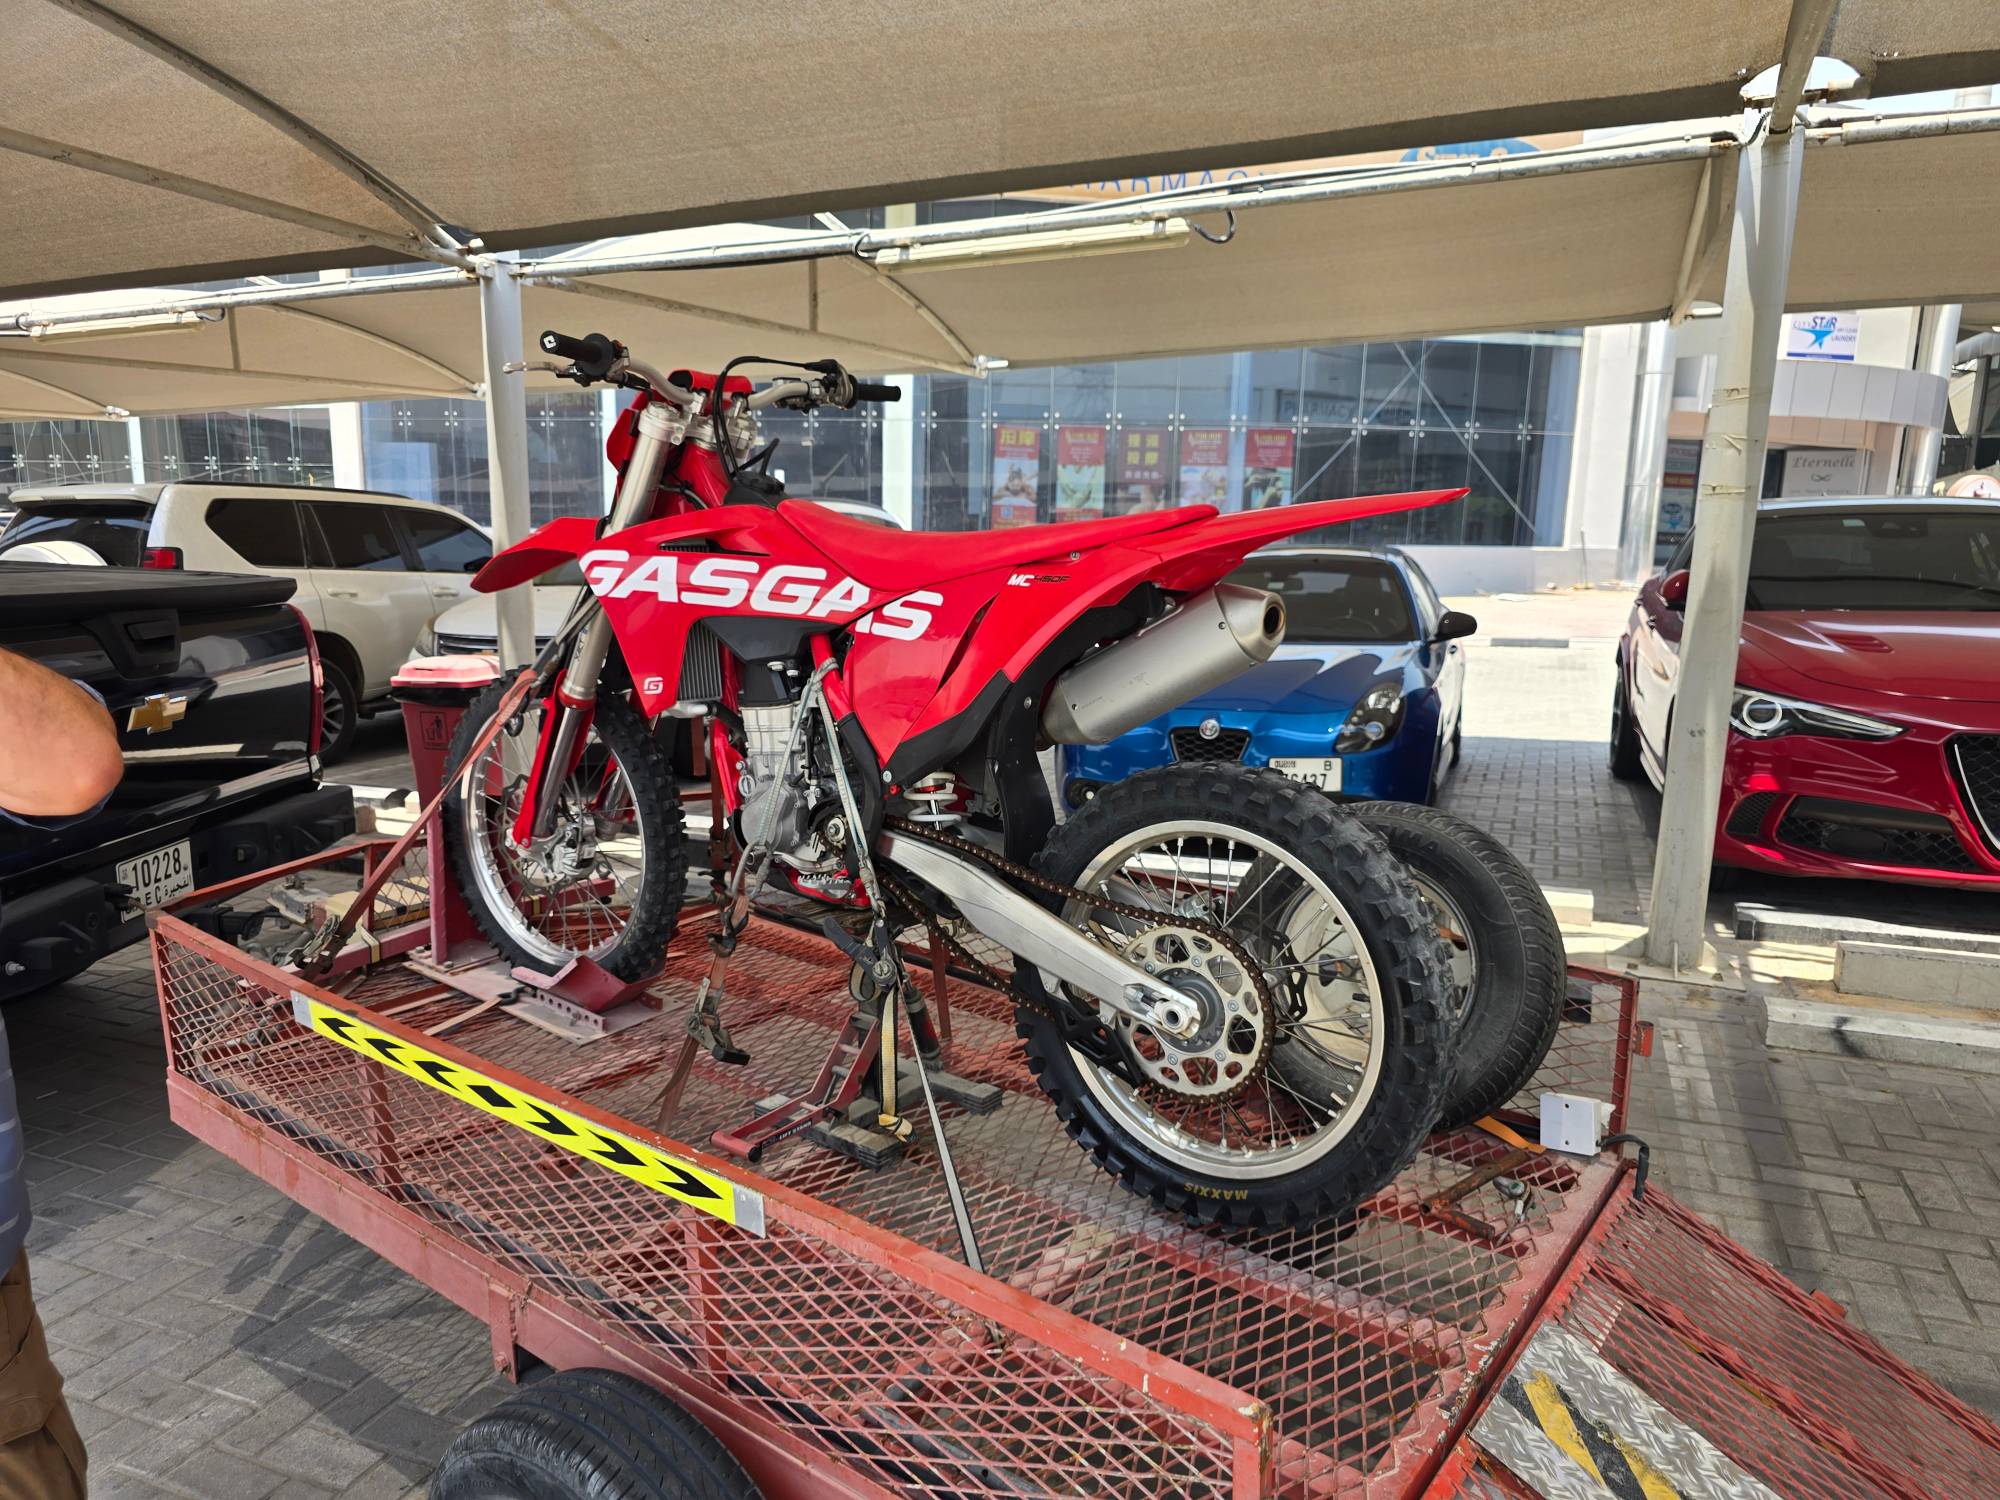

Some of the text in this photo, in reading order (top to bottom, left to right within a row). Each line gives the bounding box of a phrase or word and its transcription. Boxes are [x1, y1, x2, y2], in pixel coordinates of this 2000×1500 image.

[1007, 573, 1035, 587] MC
[578, 549, 944, 641] GASGAS
[1323, 760, 1332, 771] B
[131, 847, 181, 891] 10228
[779, 1130, 791, 1140] LIFT
[1183, 1182, 1249, 1201] MAXXIS
